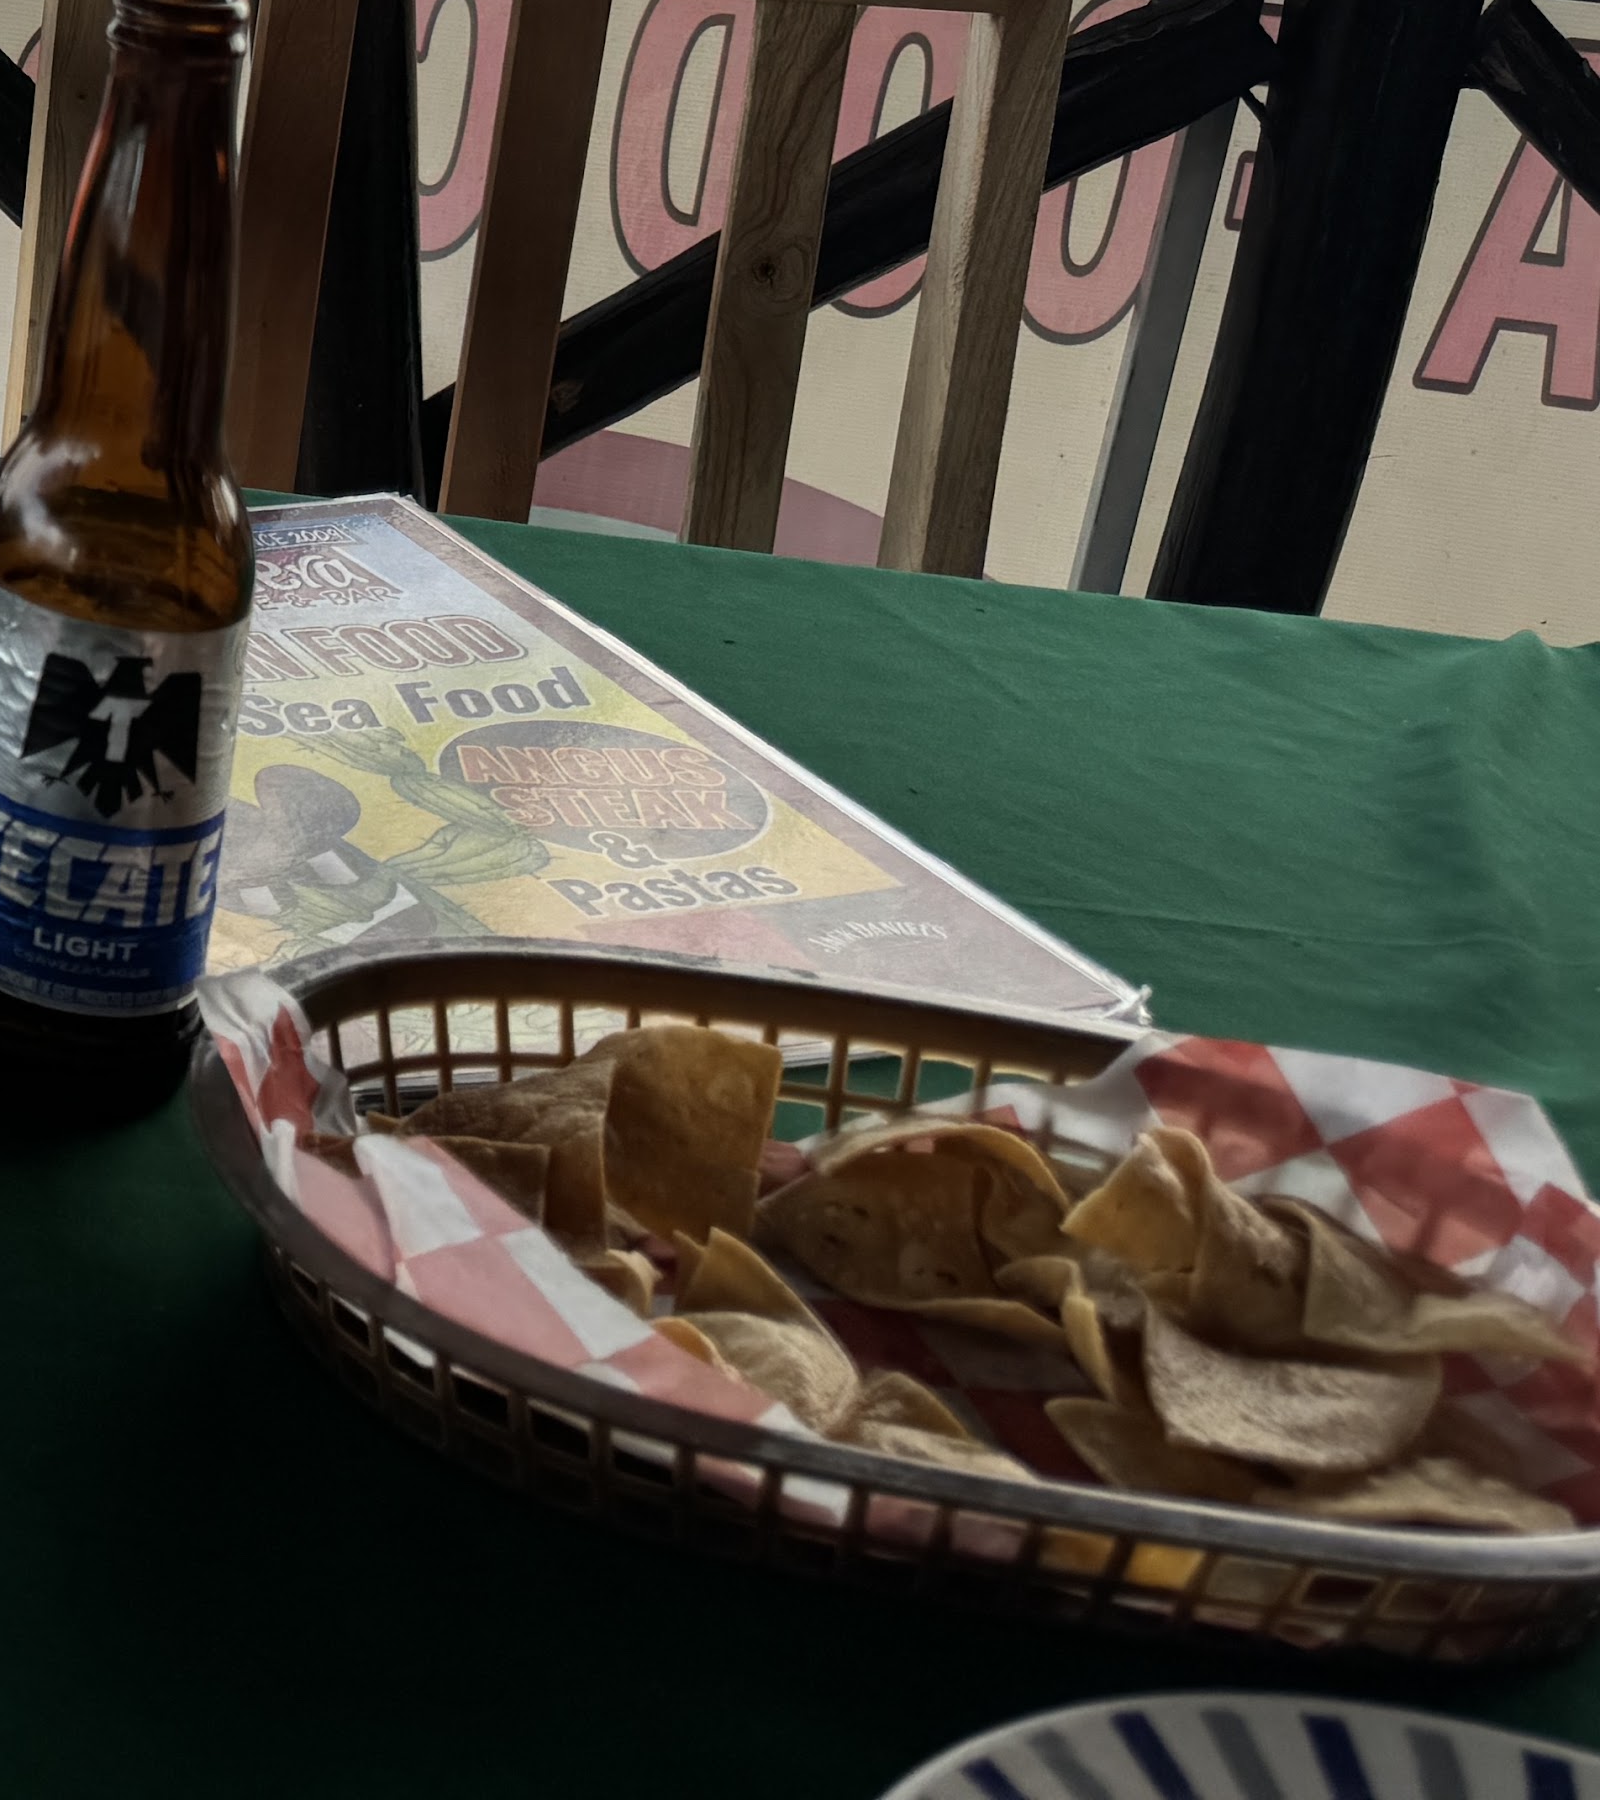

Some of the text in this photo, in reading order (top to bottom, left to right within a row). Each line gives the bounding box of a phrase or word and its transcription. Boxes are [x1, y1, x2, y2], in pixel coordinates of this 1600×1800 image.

[289, 527, 344, 544] 2009
[320, 585, 401, 606] BAR
[283, 614, 527, 677] FOOD
[237, 665, 592, 737] Sea Food
[455, 743, 727, 787] ANGUS
[490, 785, 760, 832] STEAK
[589, 830, 669, 869] &
[548, 864, 800, 918] Pastas
[33, 926, 139, 962] LIGHT
